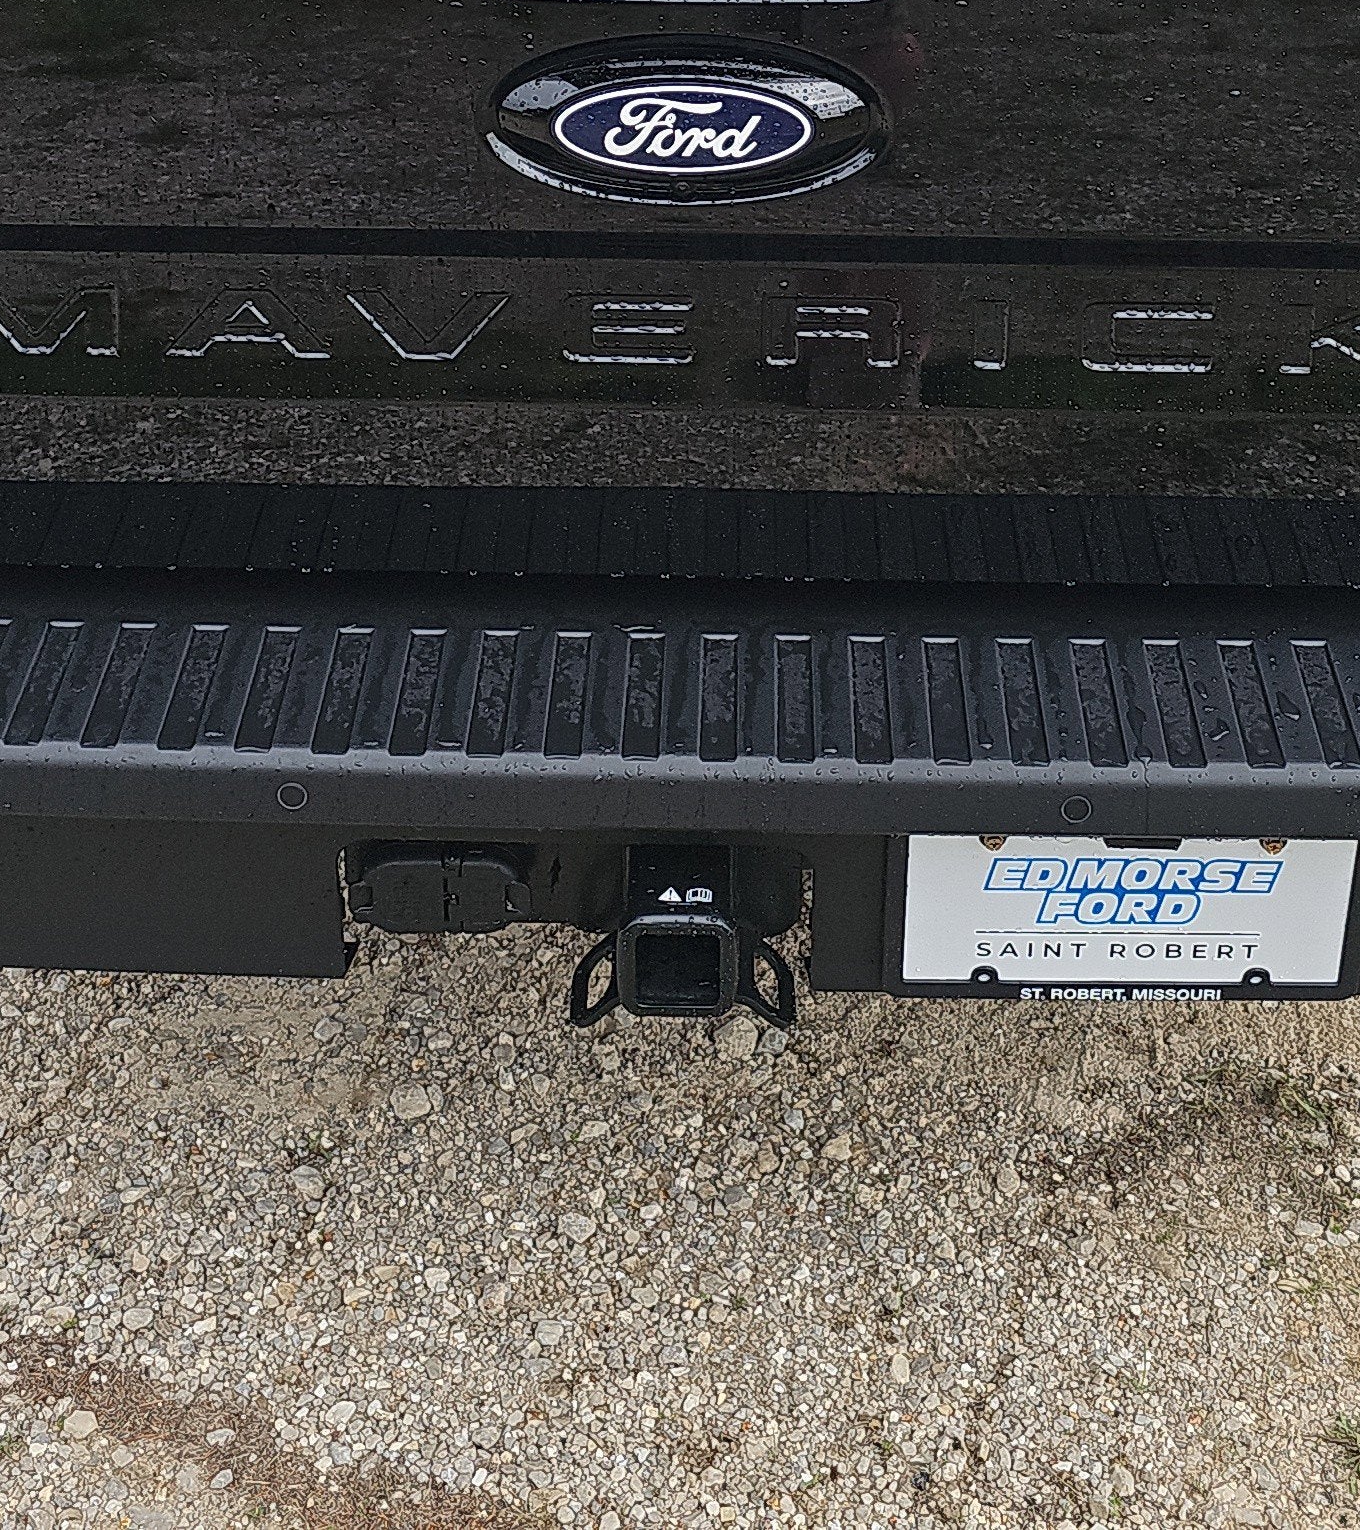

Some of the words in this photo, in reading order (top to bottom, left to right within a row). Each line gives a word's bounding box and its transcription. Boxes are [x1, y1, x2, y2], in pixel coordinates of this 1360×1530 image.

[604, 96, 762, 158] Ford
[983, 857, 1068, 892] ED
[1065, 858, 1285, 894] MORSE
[1036, 891, 1202, 925] FORD
[976, 941, 1087, 958] SAINT
[1109, 942, 1261, 959] ROBERT
[1019, 987, 1047, 1000] ST.
[1050, 988, 1128, 1002] ROBERT,
[1131, 988, 1222, 1001] MISSOURI
